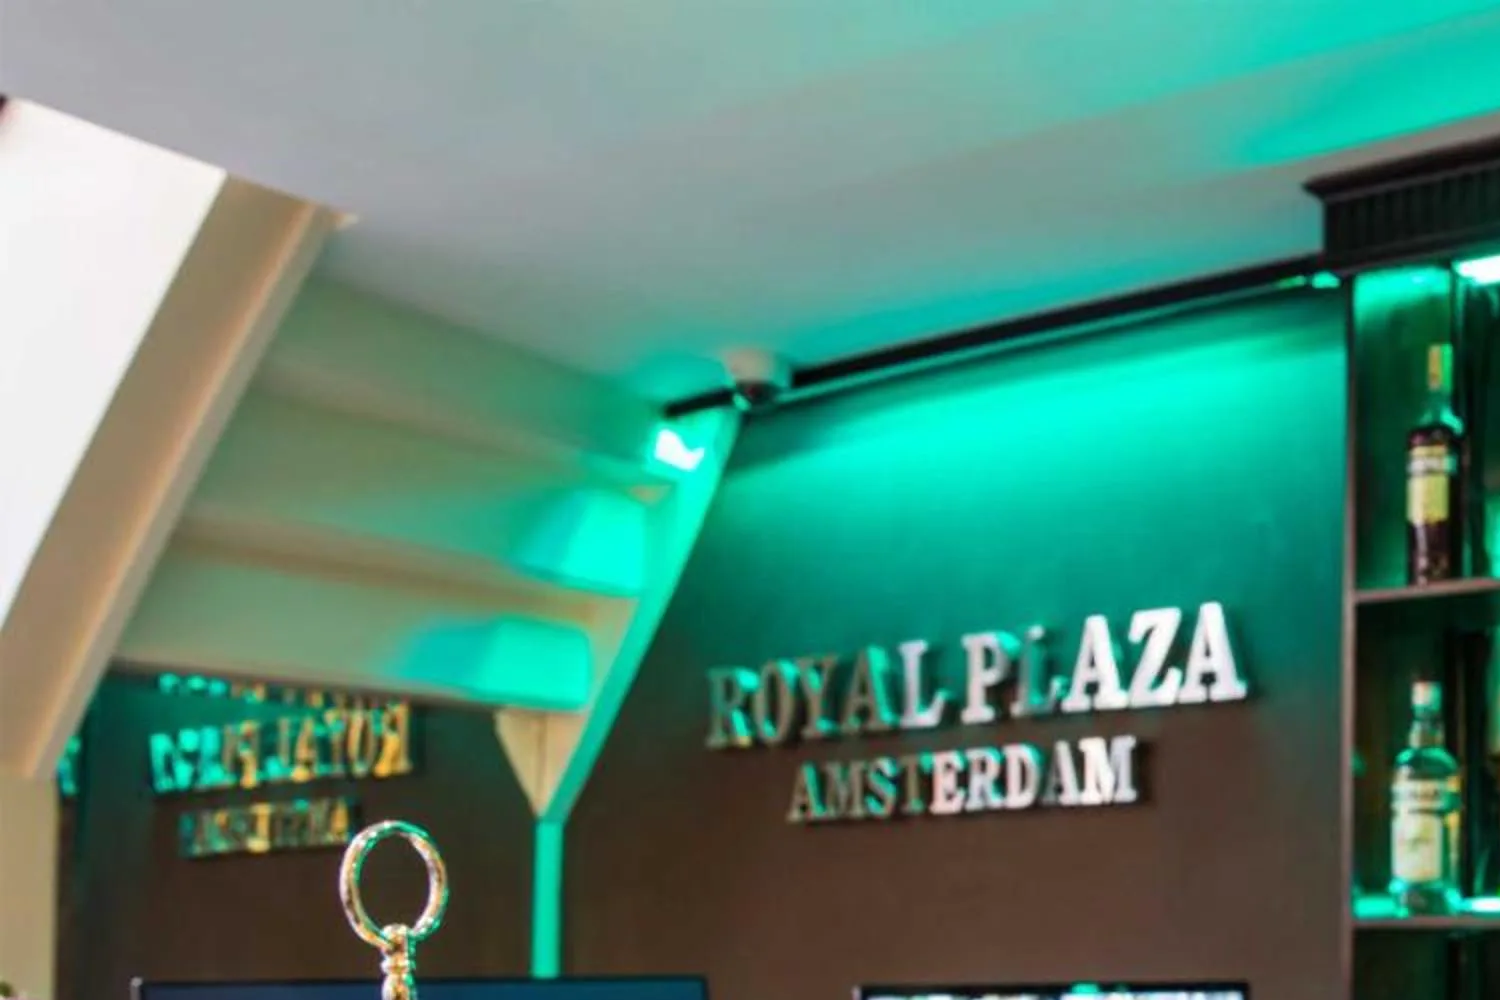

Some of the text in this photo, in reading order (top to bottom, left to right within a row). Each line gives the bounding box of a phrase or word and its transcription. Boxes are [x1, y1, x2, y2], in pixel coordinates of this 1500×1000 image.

[705, 602, 1247, 748] ROYAL PLAZA
[787, 734, 1138, 822] AMSTERDAM
